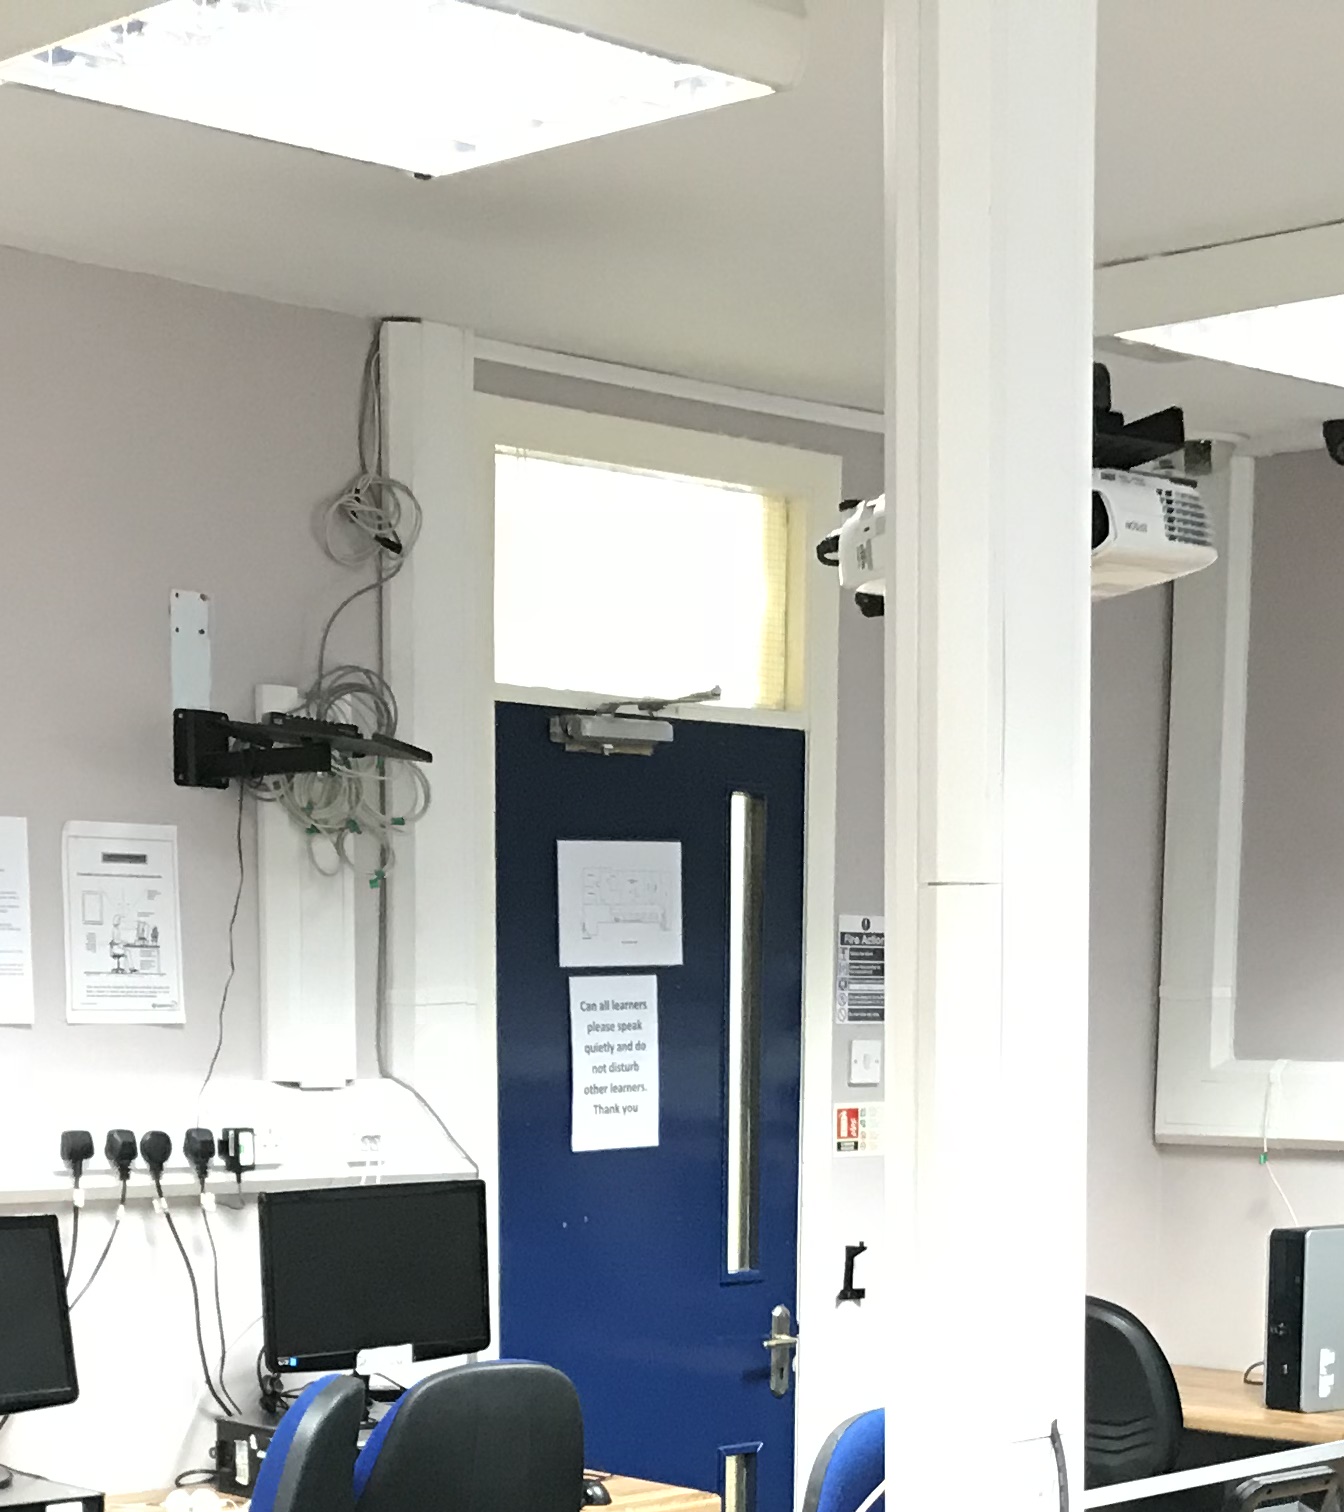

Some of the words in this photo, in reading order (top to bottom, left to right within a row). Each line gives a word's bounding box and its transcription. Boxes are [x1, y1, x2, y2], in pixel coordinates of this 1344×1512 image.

[580, 1000, 597, 1012] Can
[599, 1000, 610, 1011] all
[612, 999, 648, 1011] learners
[586, 1021, 615, 1035] please
[617, 1019, 642, 1033] speak
[584, 1041, 615, 1055] quietly
[616, 1040, 633, 1052] and
[635, 1040, 646, 1051] do
[592, 1064, 607, 1074] not
[609, 1061, 639, 1073] disturb
[583, 1083, 608, 1095] other
[610, 1082, 648, 1094] learners.
[593, 1103, 620, 1115] Thank
[622, 1104, 639, 1116] you
